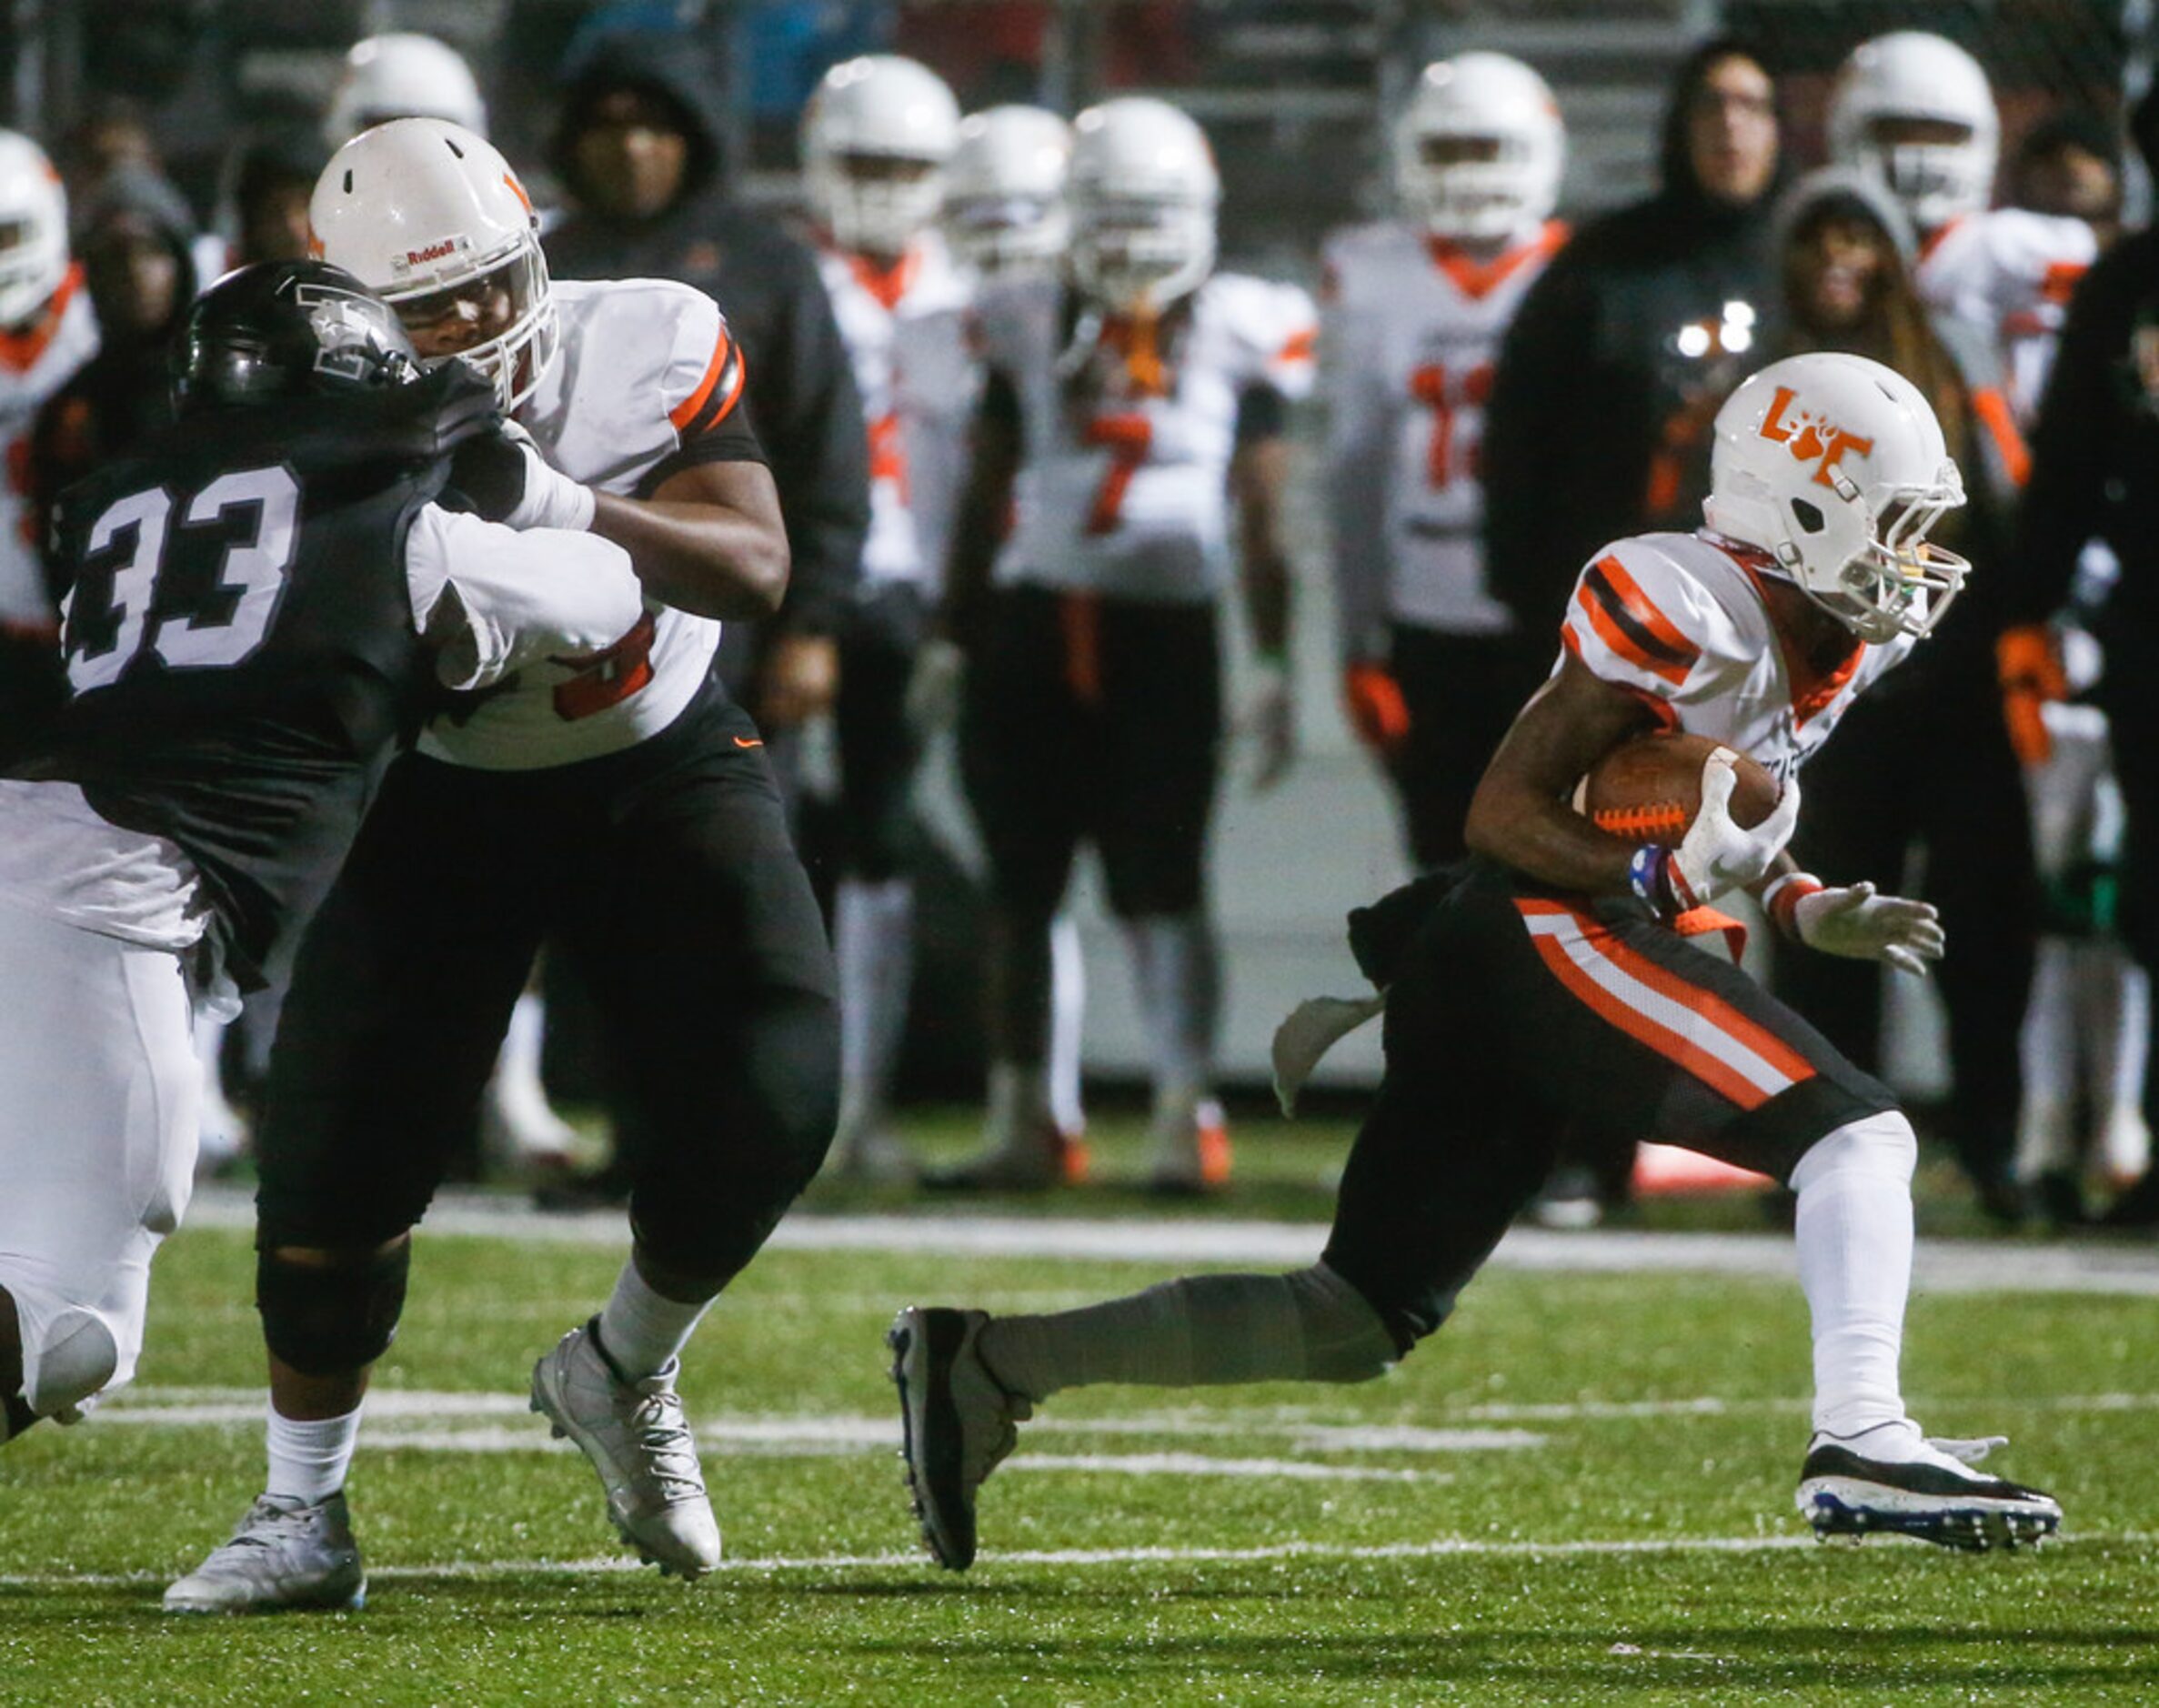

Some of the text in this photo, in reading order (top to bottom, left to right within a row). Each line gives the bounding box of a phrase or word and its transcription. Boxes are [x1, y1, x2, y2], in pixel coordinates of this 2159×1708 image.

[407, 239, 455, 266] Riddell
[1082, 414, 1152, 535] 7
[67, 465, 299, 698] 33
